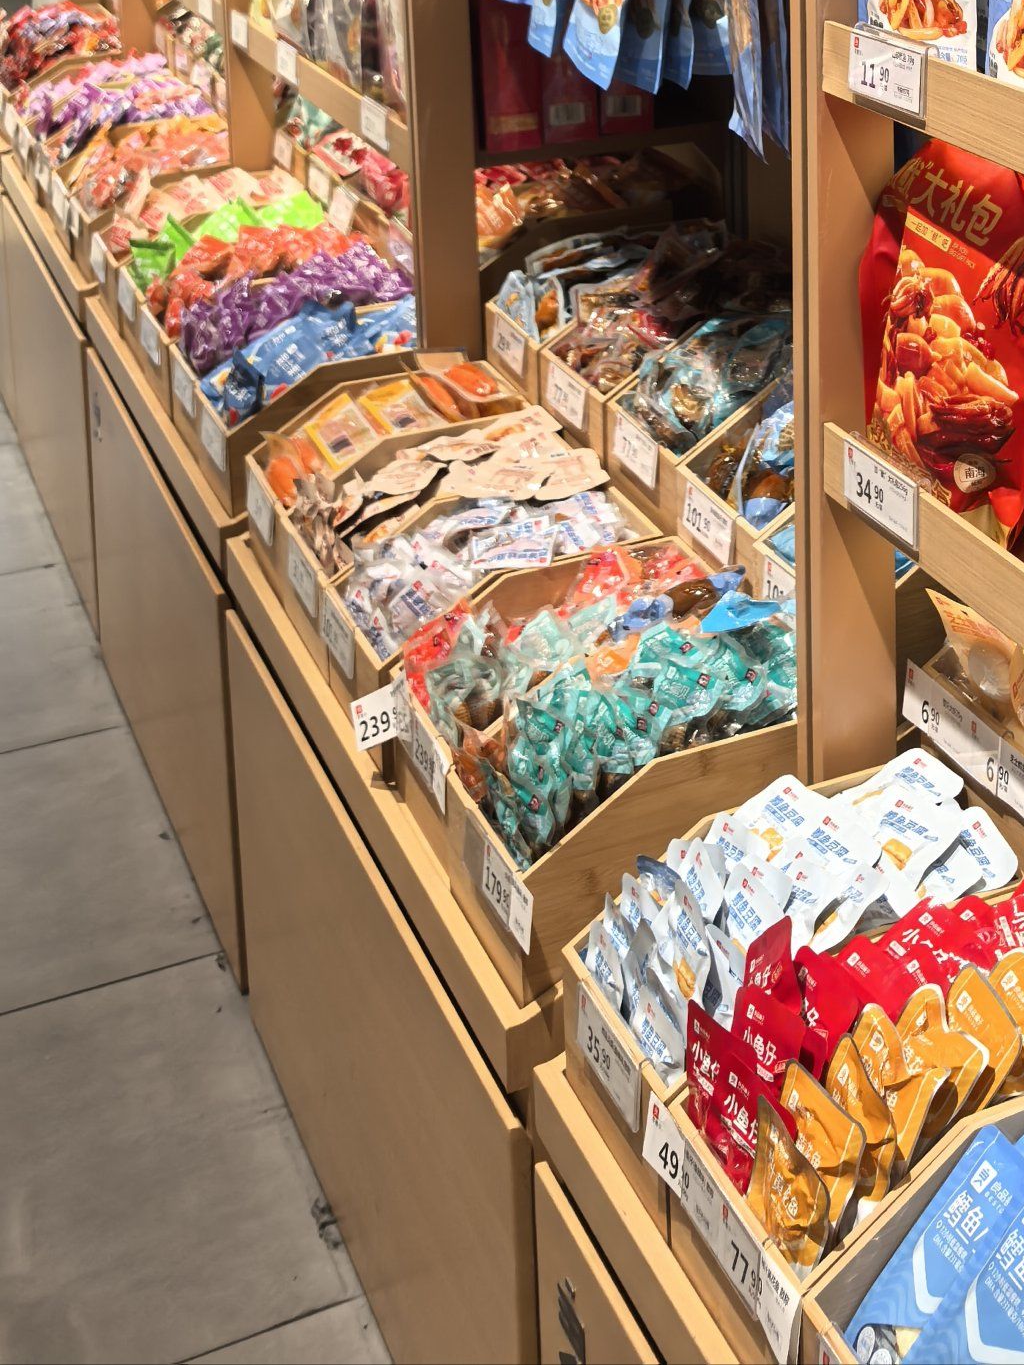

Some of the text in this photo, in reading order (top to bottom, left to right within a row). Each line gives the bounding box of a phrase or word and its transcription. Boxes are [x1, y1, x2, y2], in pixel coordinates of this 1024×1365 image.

[861, 62, 890, 89] 11 90
[856, 472, 884, 504] 34 90
[685, 503, 702, 532] 101
[359, 711, 391, 743] 239
[921, 700, 930, 724] 6
[930, 707, 940, 726] 90
[985, 756, 995, 784] 6
[998, 766, 1009, 786] 90
[485, 866, 501, 903] 179
[586, 1026, 611, 1070] 35 90
[743, 1028, 777, 1067] 小鱼仔
[658, 1142, 679, 1180] 49
[730, 1240, 749, 1284] 77
